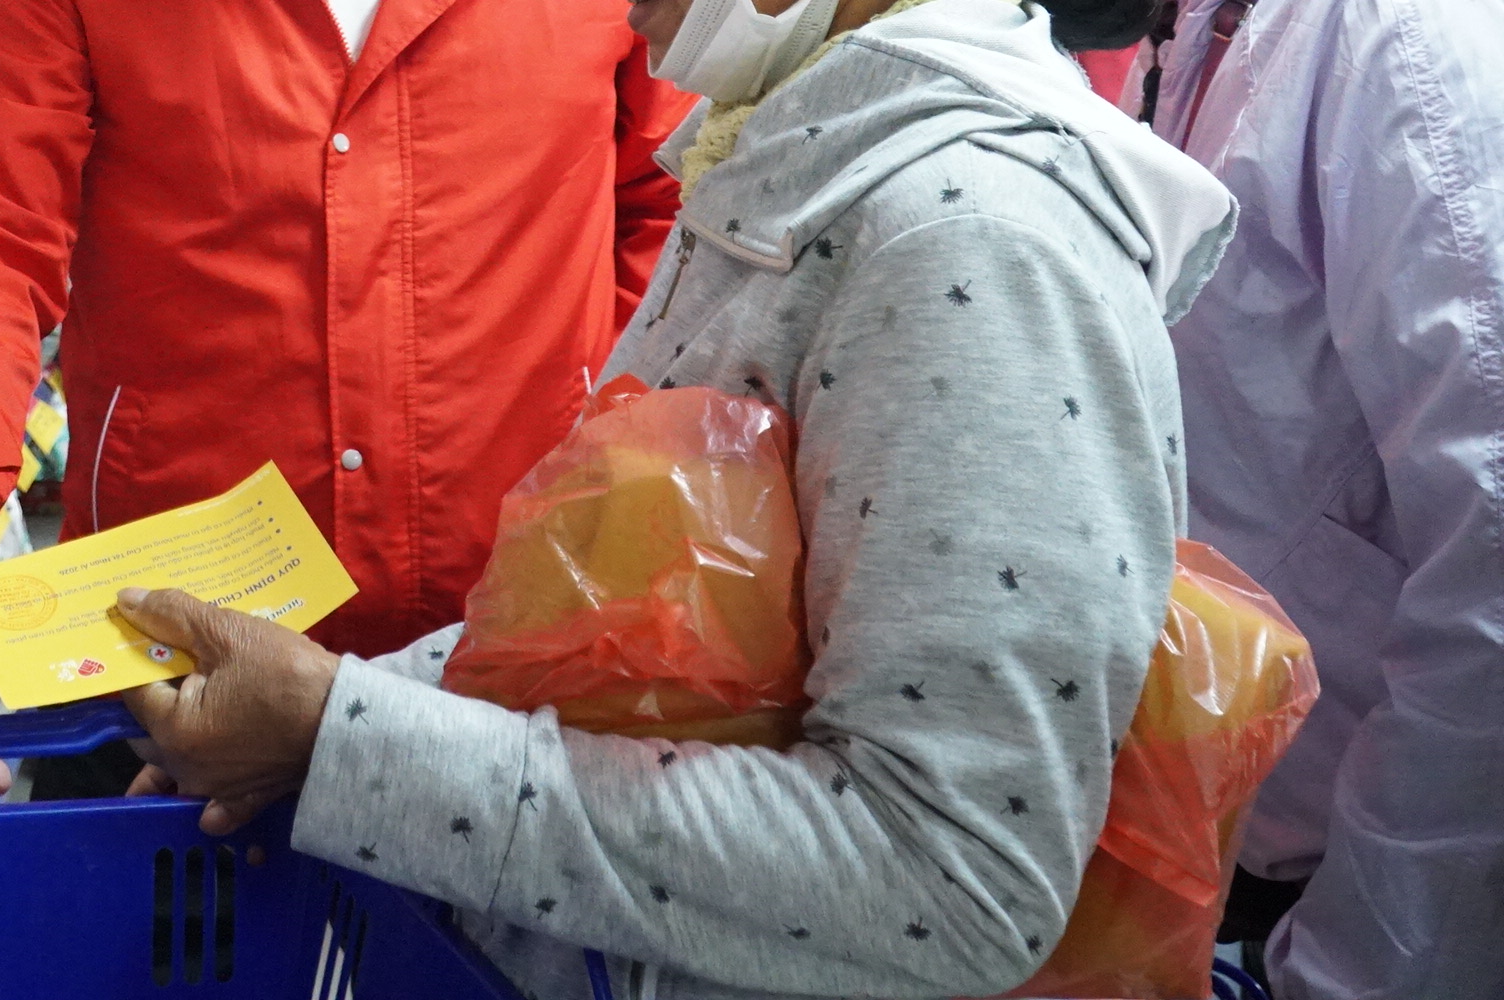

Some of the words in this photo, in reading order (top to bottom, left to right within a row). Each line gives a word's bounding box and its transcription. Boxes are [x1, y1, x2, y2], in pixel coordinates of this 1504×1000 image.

[278, 557, 301, 577] QUY
[207, 591, 243, 608] CHUN
[265, 599, 299, 621] HEINE
